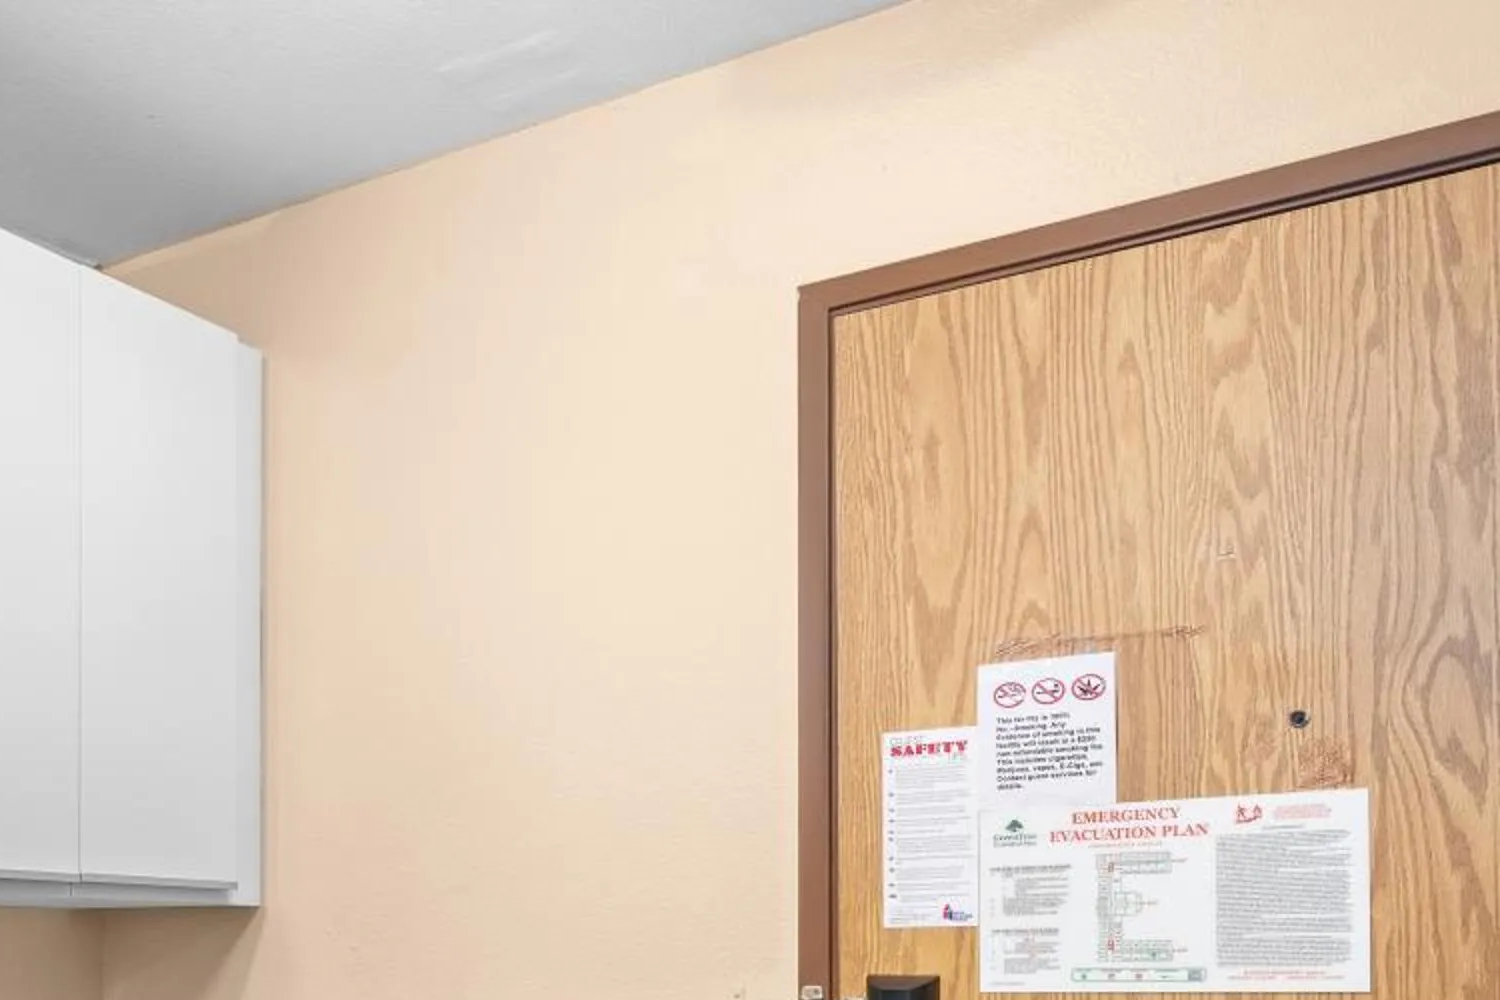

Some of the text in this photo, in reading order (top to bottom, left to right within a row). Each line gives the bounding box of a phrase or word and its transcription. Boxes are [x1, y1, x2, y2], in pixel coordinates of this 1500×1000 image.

[890, 740, 968, 757] SAFETY
[1072, 805, 1181, 825] EMERGENCY
[1049, 823, 1209, 844] EVACUATION PLAN
